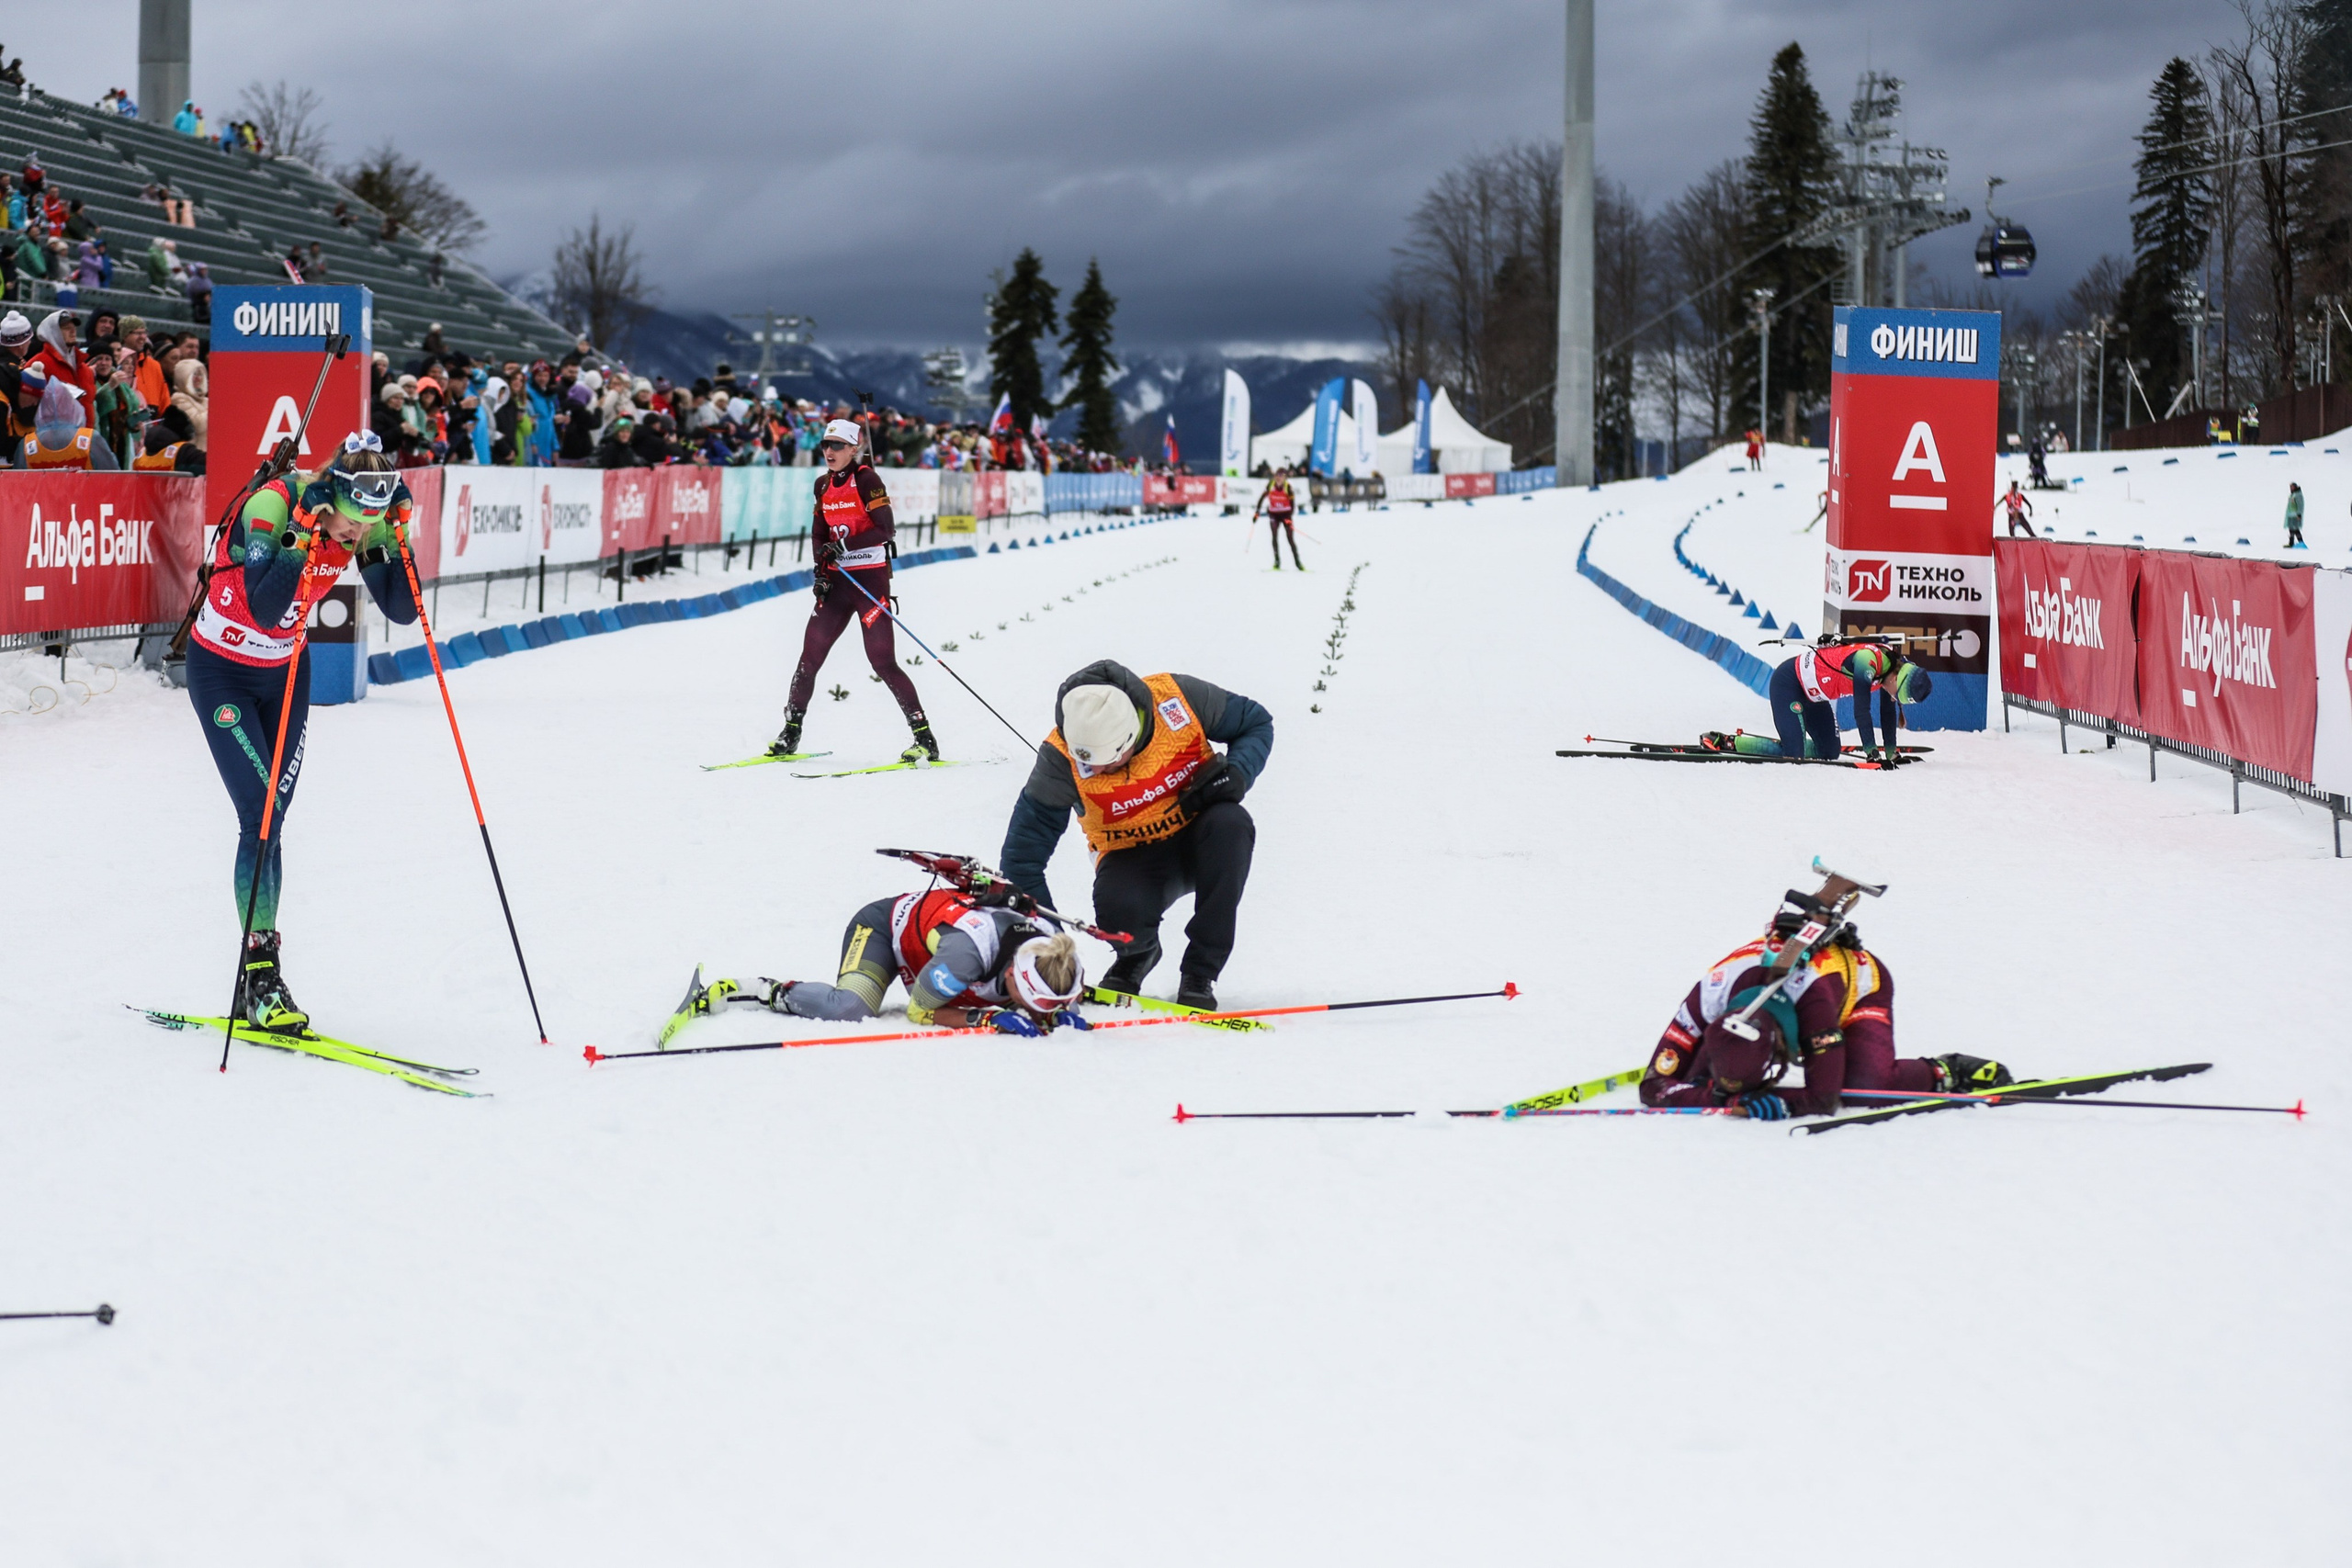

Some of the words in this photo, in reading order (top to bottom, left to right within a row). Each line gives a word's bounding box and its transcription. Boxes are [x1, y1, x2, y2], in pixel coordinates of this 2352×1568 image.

[233, 301, 341, 337] ФИНИШ
[1871, 323, 1979, 364] ФИНИШ
[839, 501, 856, 509] Банк
[25, 502, 96, 585] Альфа
[99, 503, 154, 567] Банк
[1896, 566, 1965, 582] ТЕХНО
[220, 586, 233, 607] 5
[1899, 584, 1983, 602] НИКОЛЬ
[2060, 577, 2105, 650] Банк
[2181, 591, 2233, 698] Альфа
[2233, 600, 2278, 690] Банк
[1111, 785, 1167, 814] Альфа
[1164, 759, 1200, 789] Банк
[269, 1034, 300, 1047] FISCHER
